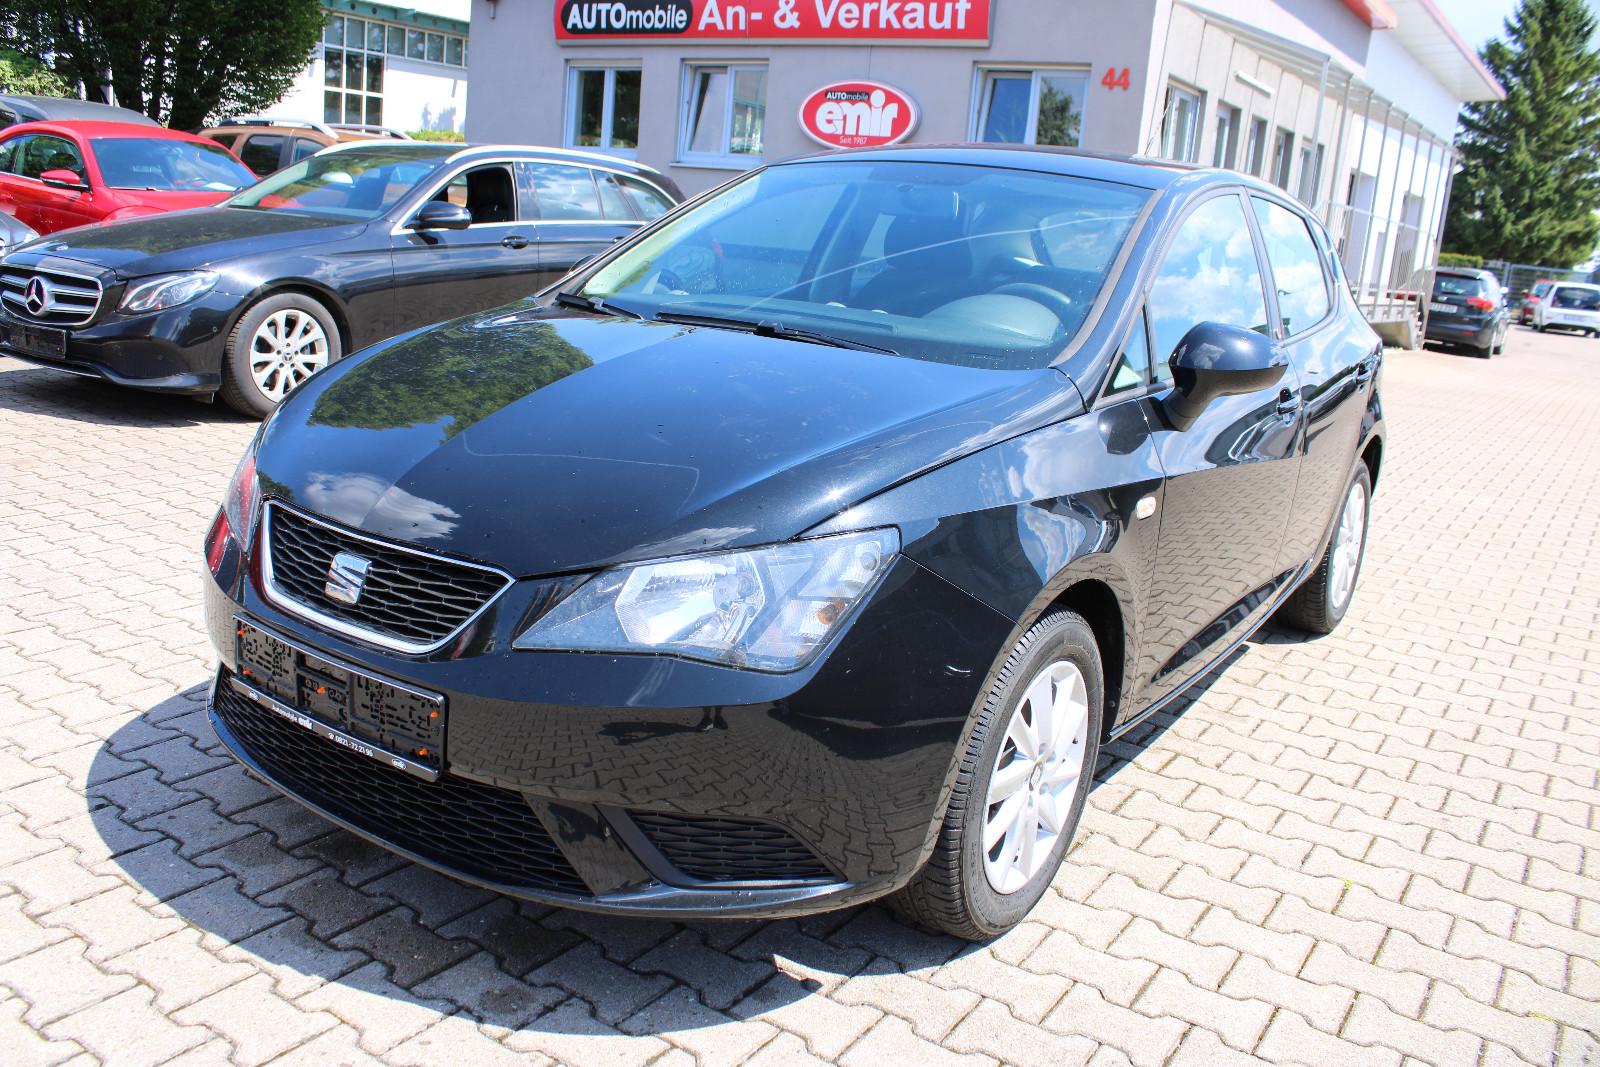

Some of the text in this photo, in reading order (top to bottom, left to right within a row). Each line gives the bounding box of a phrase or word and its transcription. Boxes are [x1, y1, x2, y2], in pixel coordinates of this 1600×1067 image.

[566, 0, 972, 31] AUTOmobile An- & Verkauf
[1101, 66, 1130, 91] 44
[826, 91, 869, 101] AUTOmobile
[815, 89, 899, 137] emir
[840, 136, 868, 145] Seit 1987
